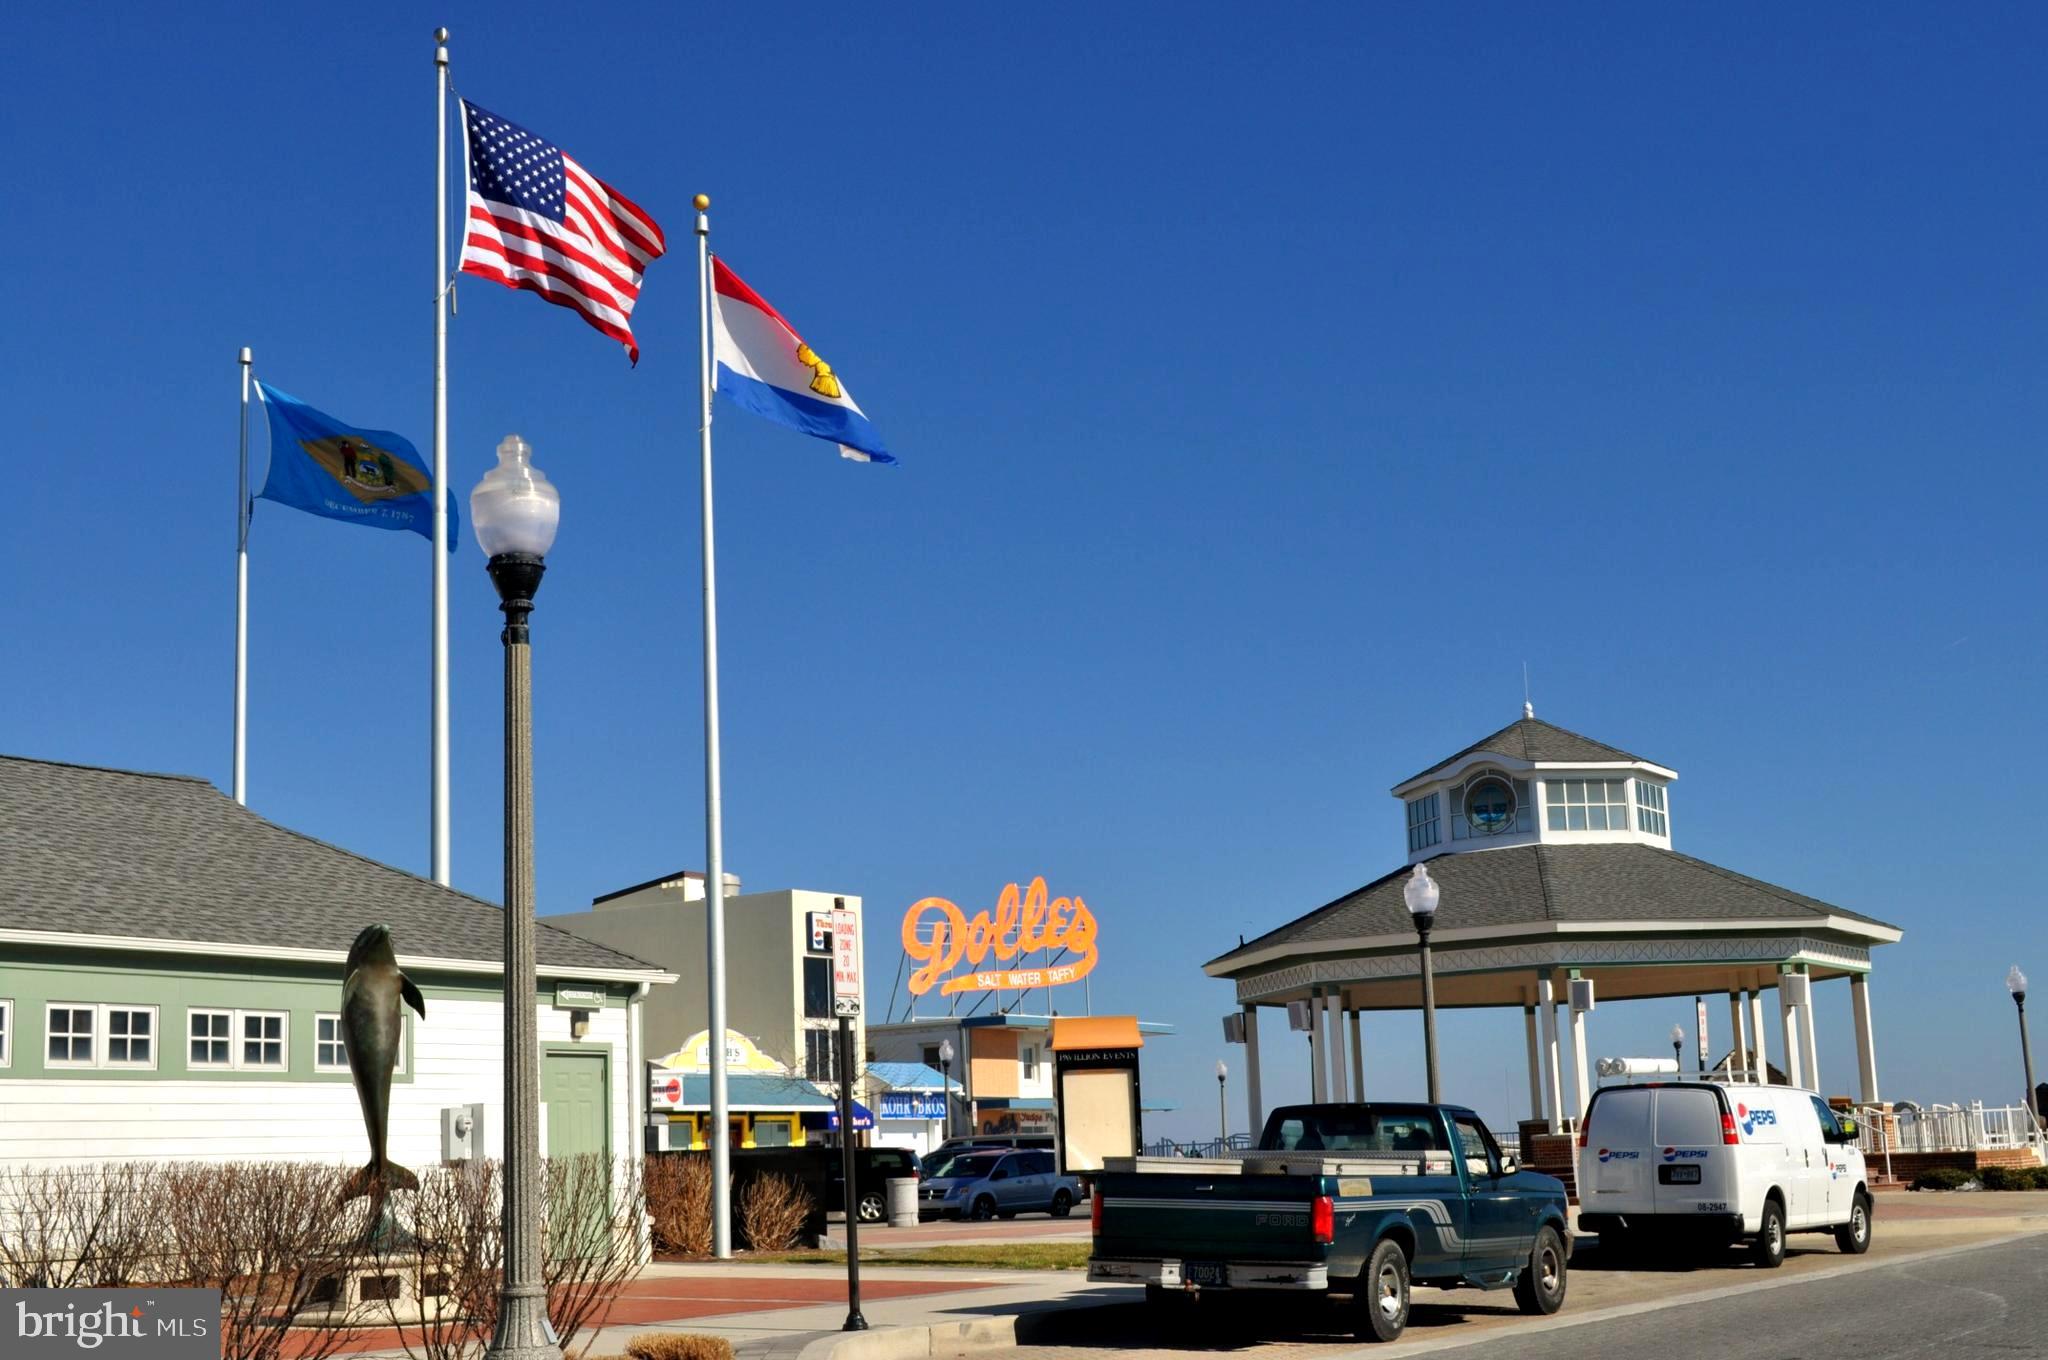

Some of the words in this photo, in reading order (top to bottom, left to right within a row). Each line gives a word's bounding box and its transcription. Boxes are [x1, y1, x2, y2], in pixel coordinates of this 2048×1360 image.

[835, 922, 855, 935] LOADING
[839, 939, 852, 951] ZONE
[843, 955, 850, 967] 20
[835, 971, 845, 982] MIN
[847, 971, 857, 983] MAX
[977, 974, 1001, 988] SALT
[1008, 972, 1042, 986] WATER
[1047, 966, 1076, 983] TAFFY
[1103, 1050, 1136, 1060] EVENTS
[881, 1096, 911, 1114] KOHR
[919, 1096, 946, 1114] BROS
[1749, 1110, 1777, 1125] PEPSI
[1609, 1151, 1640, 1159] PEPSI
[1674, 1150, 1708, 1158] PEPSI
[1255, 1214, 1309, 1227] FORD
